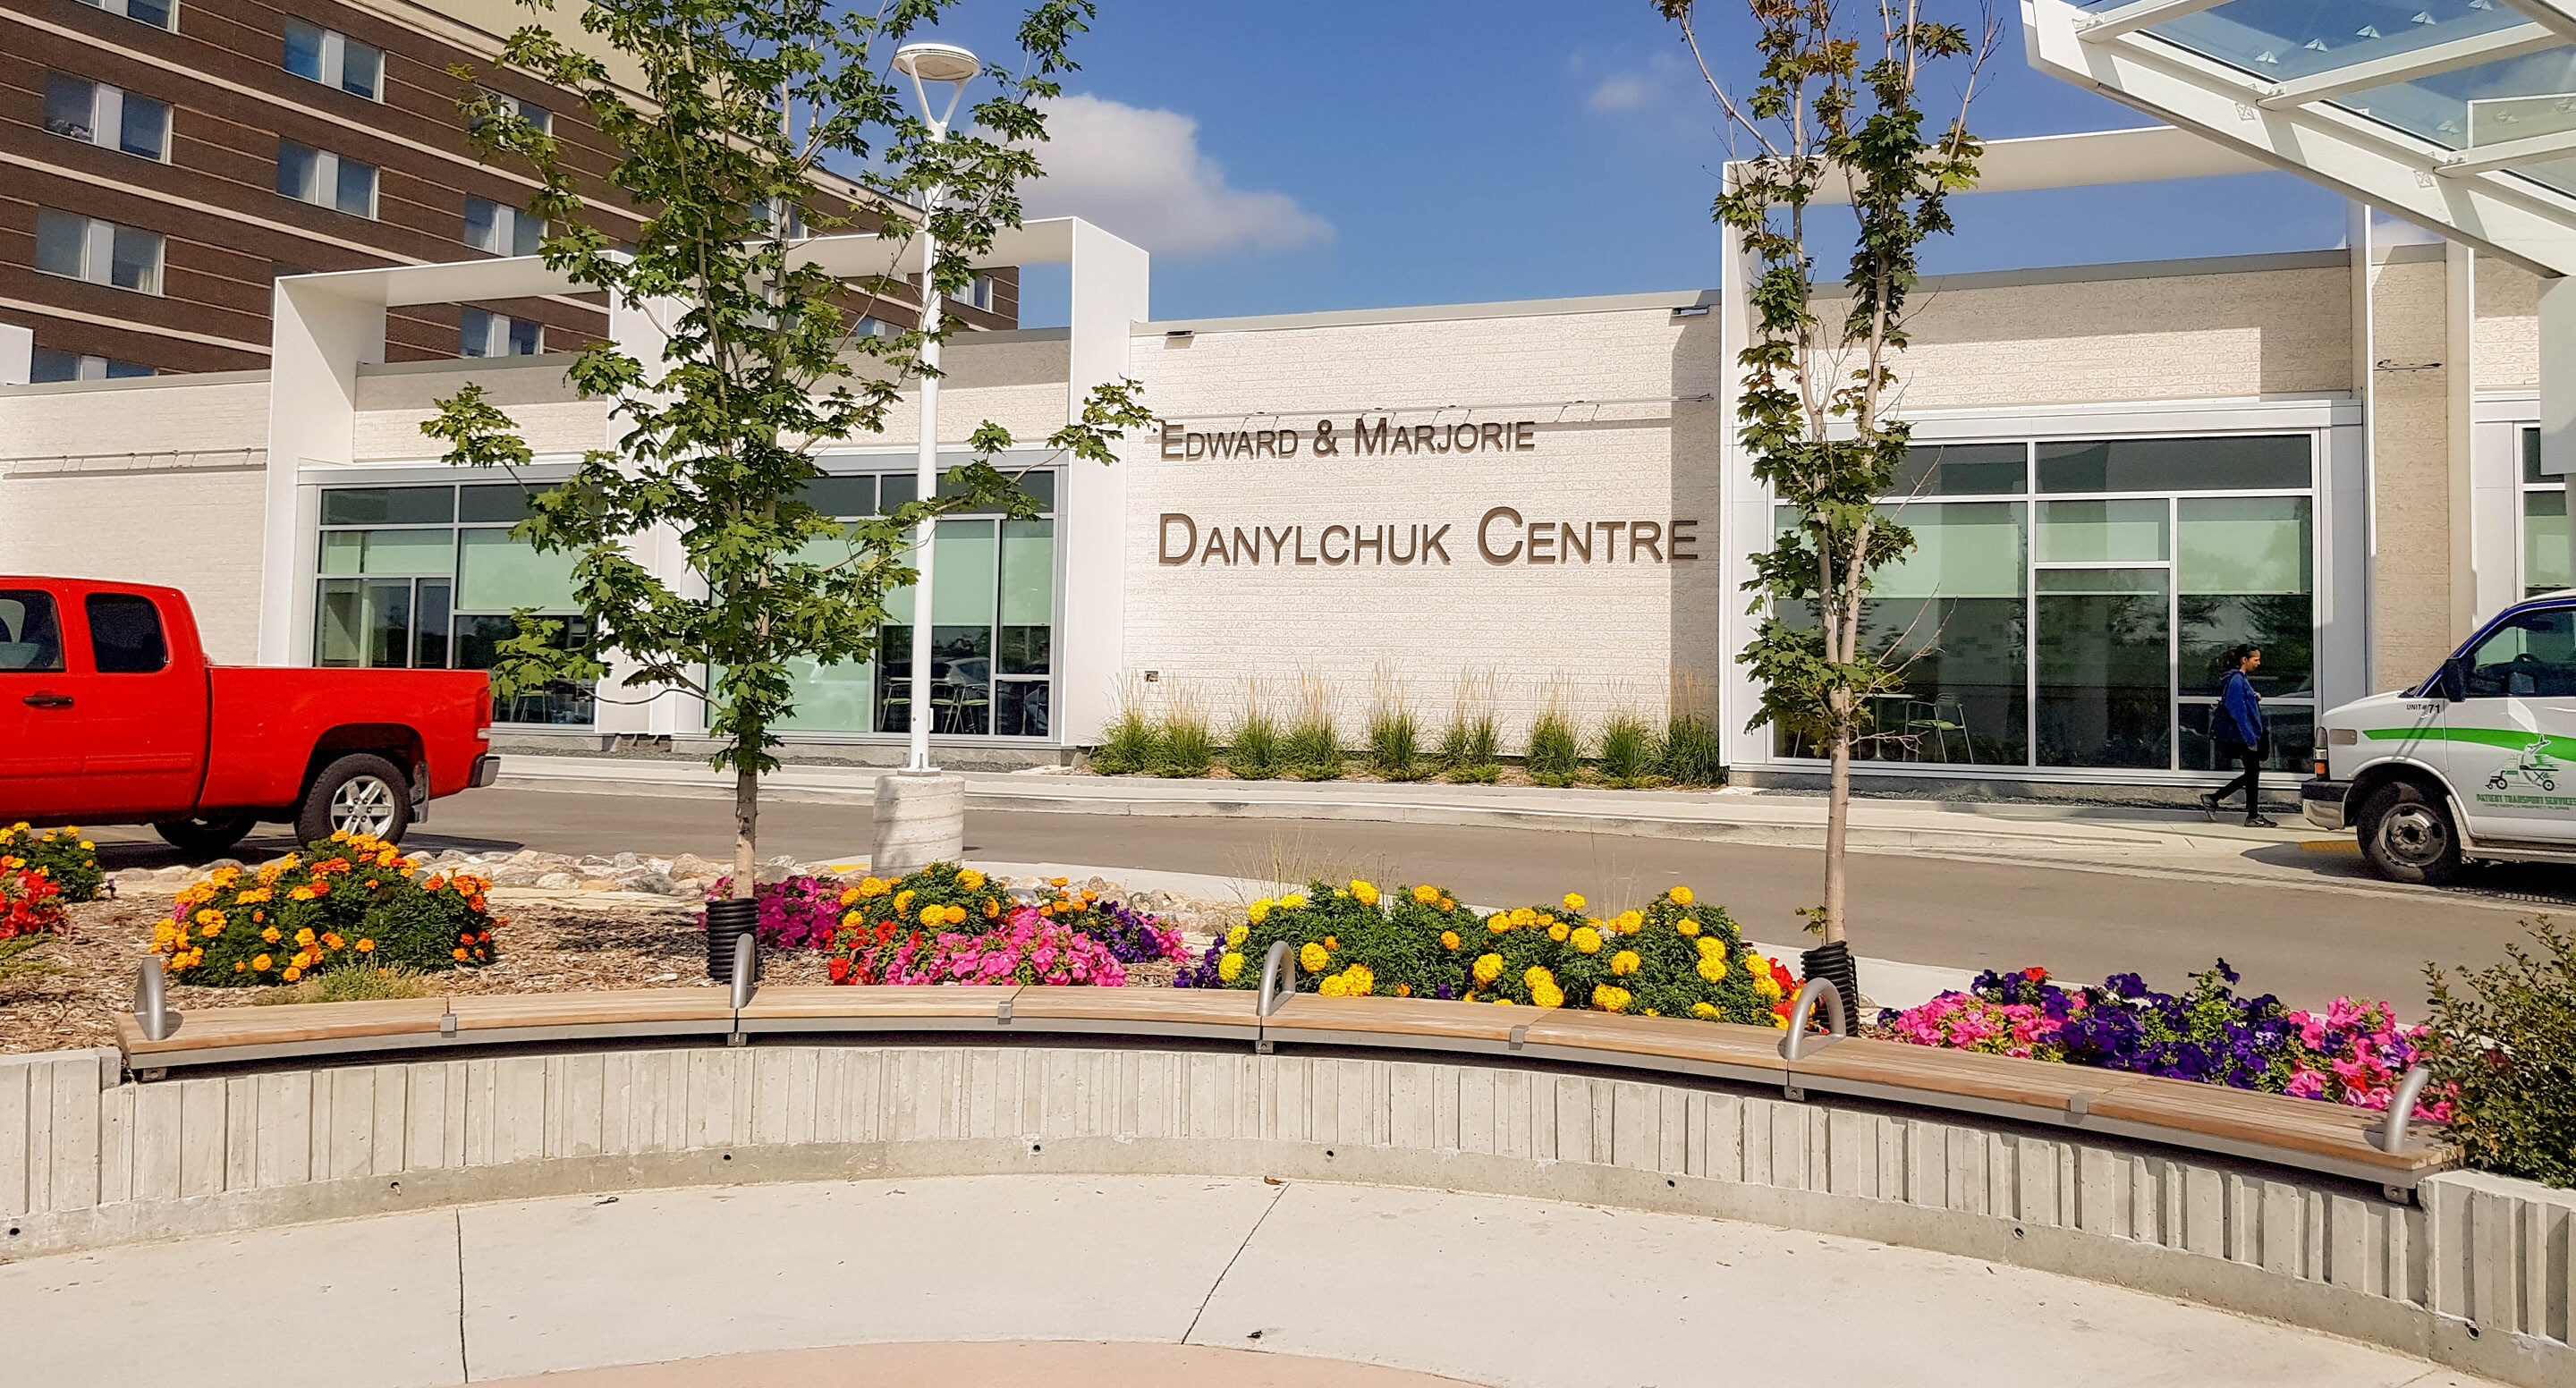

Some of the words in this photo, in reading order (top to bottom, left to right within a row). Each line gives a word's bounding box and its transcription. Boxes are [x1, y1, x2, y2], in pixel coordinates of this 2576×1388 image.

[1161, 424, 1299, 461] EDWARD
[1312, 419, 1340, 458] &
[1354, 417, 1536, 457] MARJORIE
[1158, 512, 1452, 567] DANYLCHUK
[1477, 506, 1699, 567] CENTRE
[2476, 793, 2503, 803] PATIENT
[2504, 795, 2544, 805] TRANSPORT
